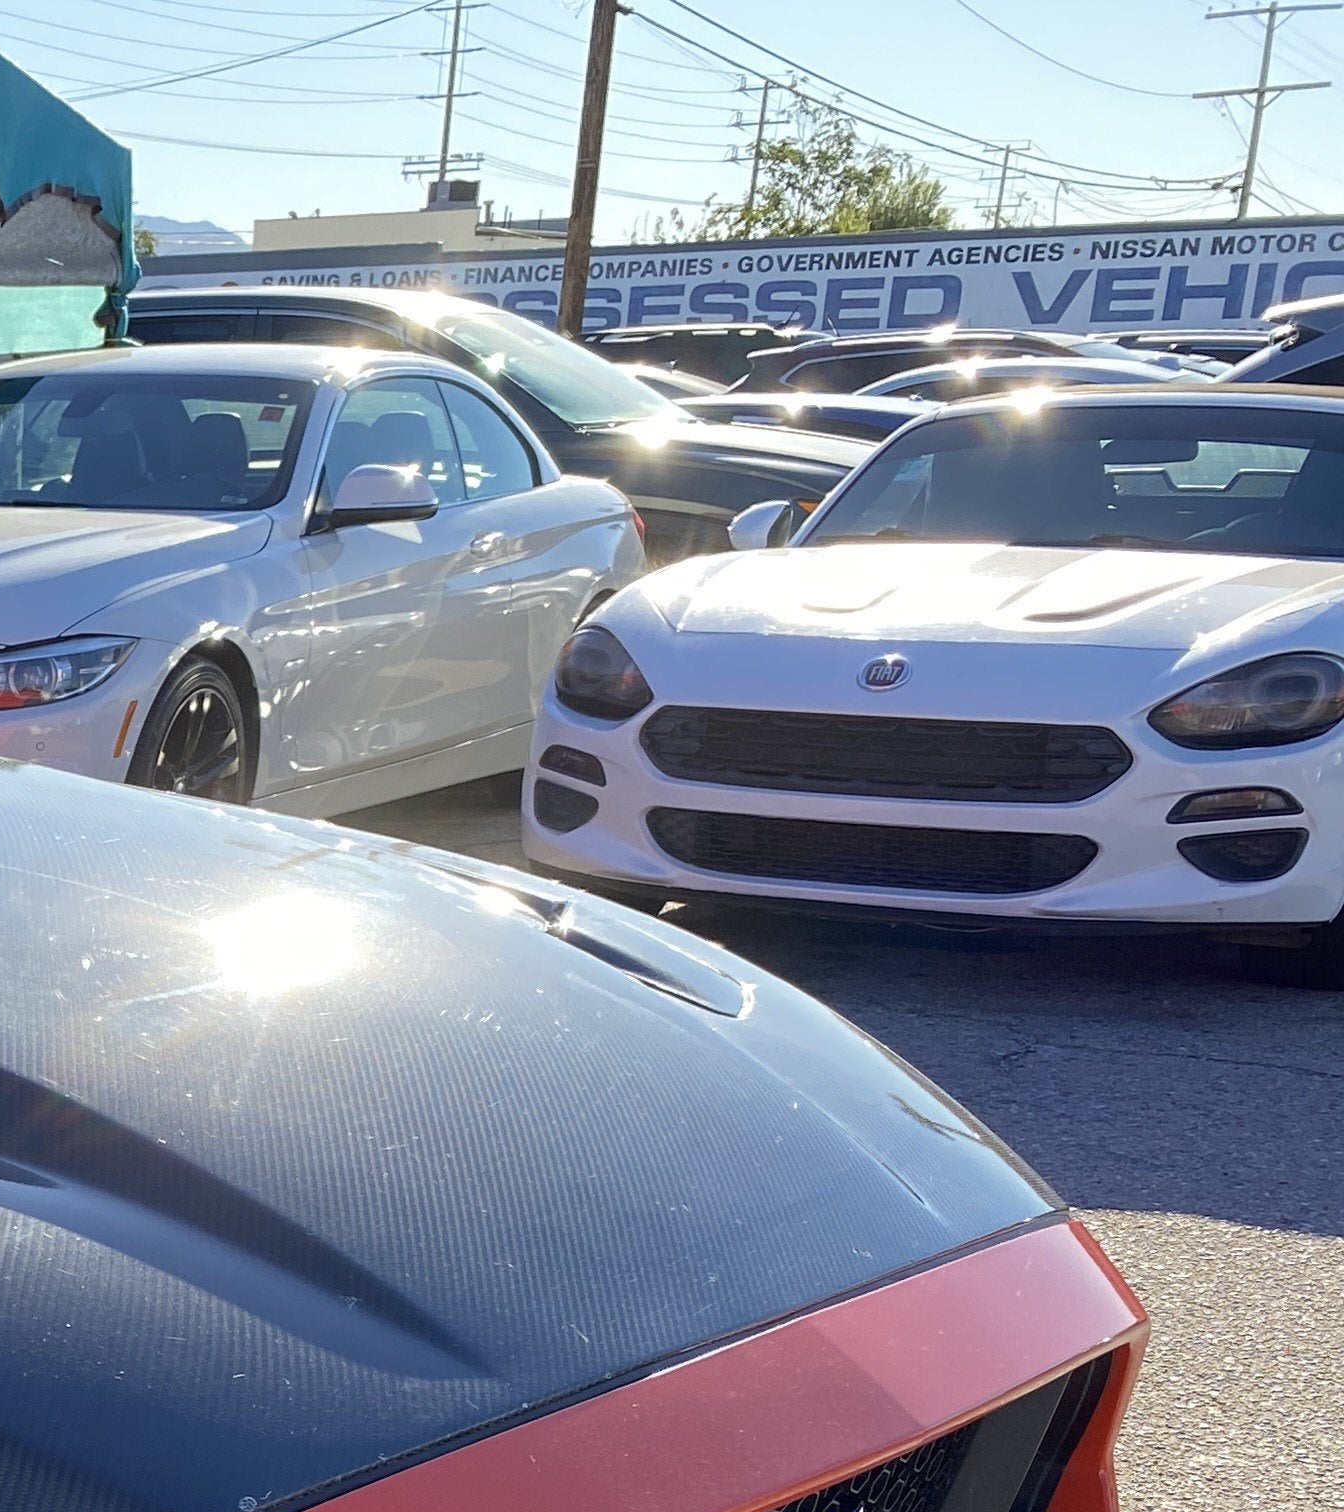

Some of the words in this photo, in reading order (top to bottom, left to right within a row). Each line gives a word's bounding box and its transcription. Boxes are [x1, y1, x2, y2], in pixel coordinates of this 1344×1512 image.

[369, 269, 442, 288] LOANS
[464, 263, 565, 285] FINANCE
[588, 257, 713, 280] OMPANIES
[737, 248, 919, 273] GOVERNMENT
[926, 242, 1066, 267] AGENCIES
[1090, 237, 1201, 260] NISSAN
[1210, 233, 1317, 256] MOTOR
[869, 665, 902, 681] FIAT
